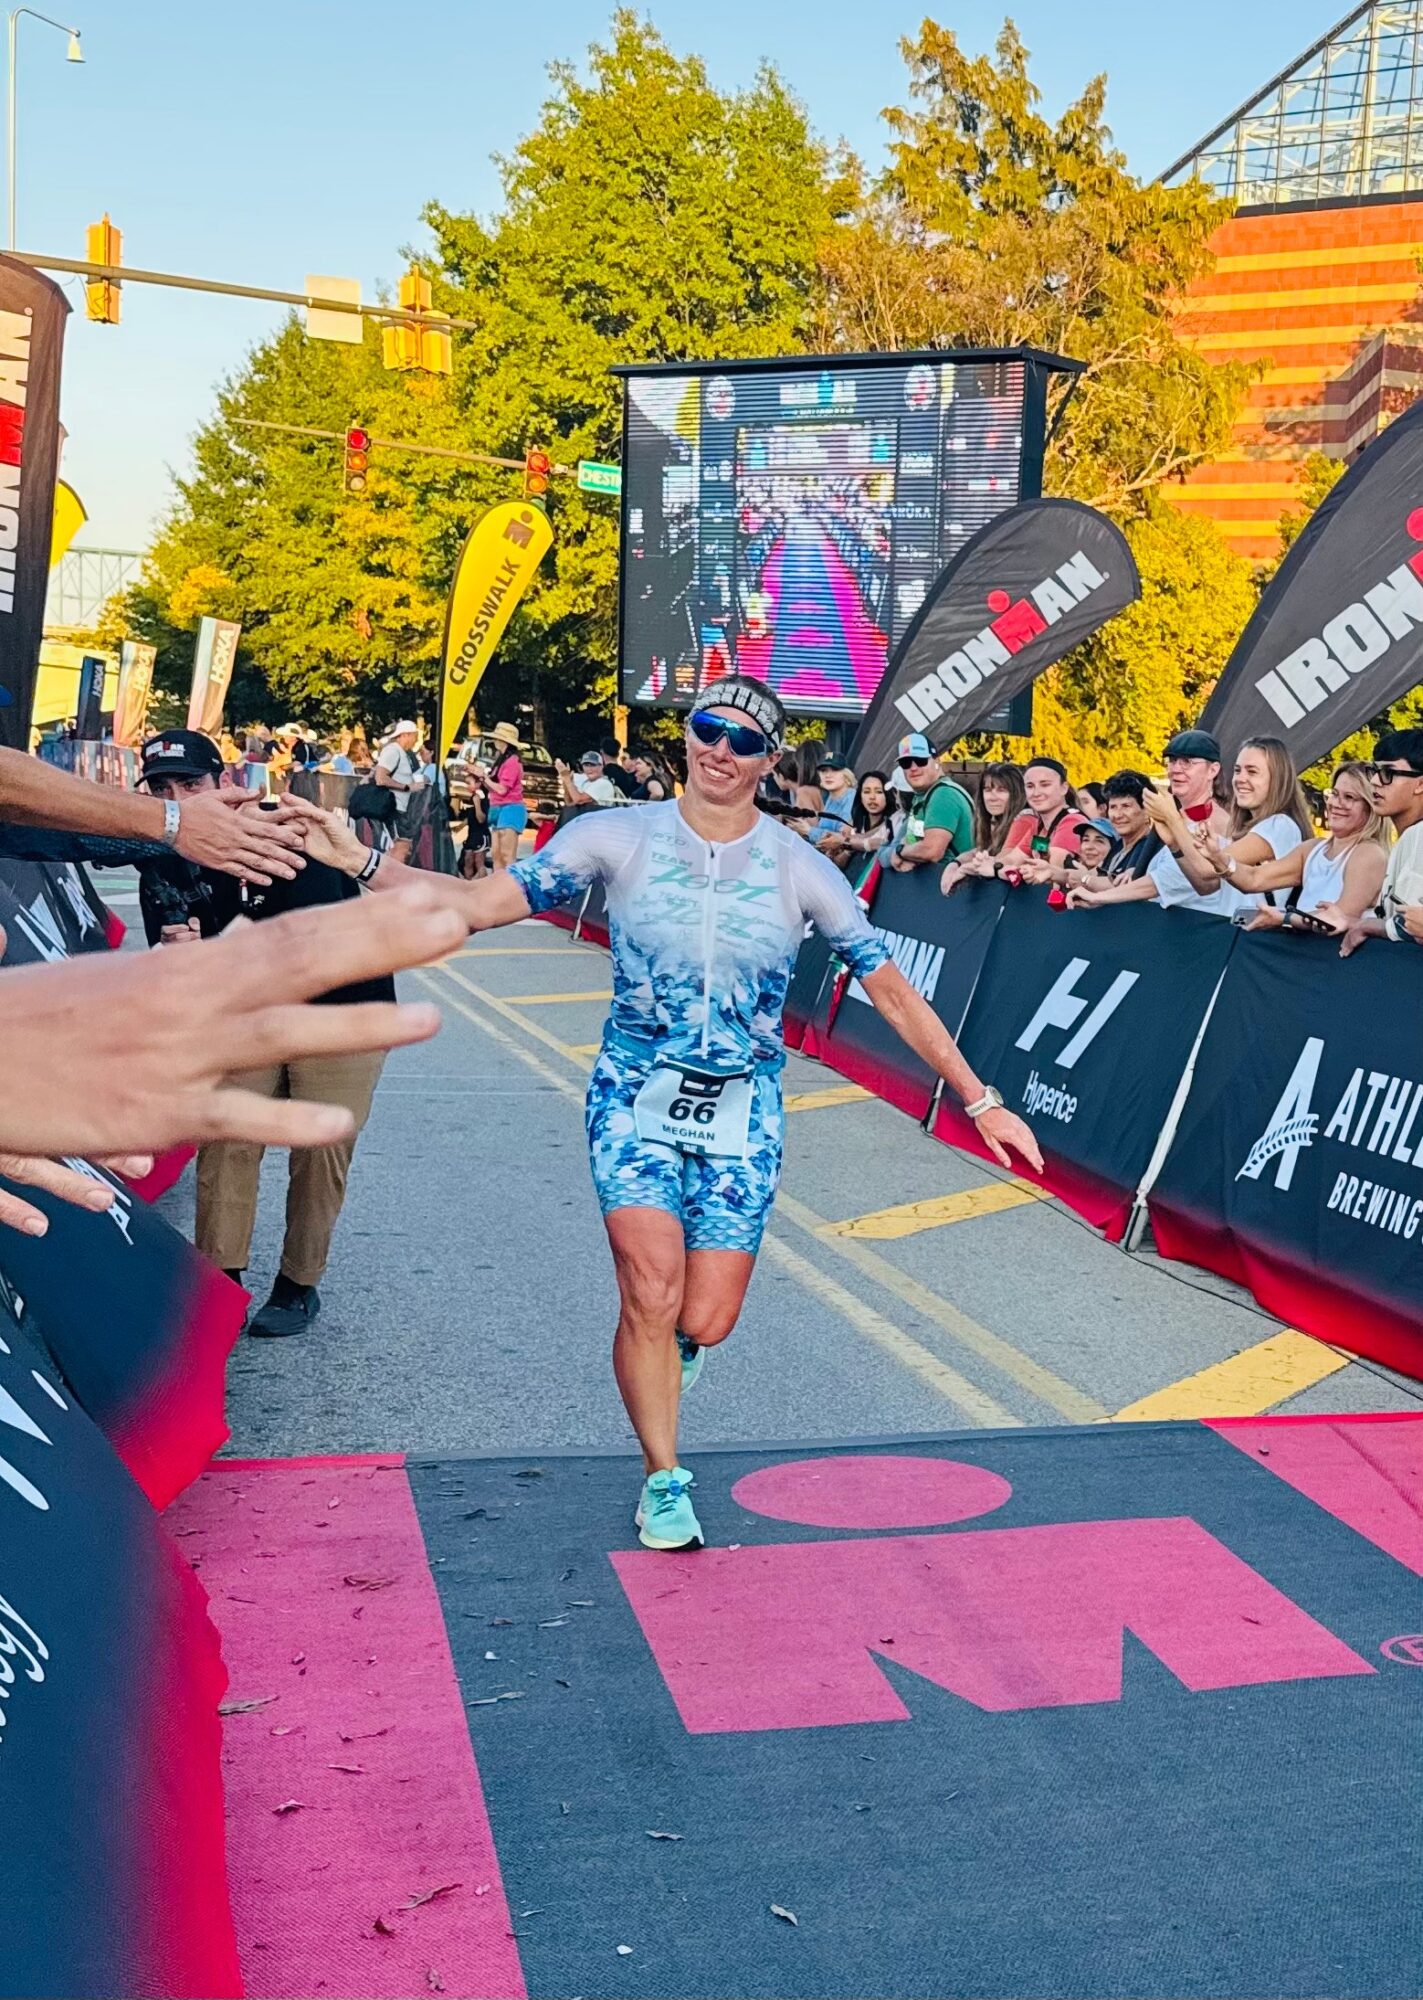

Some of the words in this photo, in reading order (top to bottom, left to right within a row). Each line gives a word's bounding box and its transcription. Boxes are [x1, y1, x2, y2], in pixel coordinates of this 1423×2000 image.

[449, 557, 520, 686] CROSSWALK
[894, 550, 1106, 733] IRONMAN
[1255, 546, 1423, 729] IRON
[91, 664, 104, 697] HOKA
[133, 649, 151, 692] HOKA
[210, 629, 235, 685] HOKA
[651, 851, 693, 867] TEAM
[872, 926, 946, 1002] VANA
[668, 1097, 717, 1125] 66
[1021, 1069, 1078, 1124] Hyperice
[662, 1123, 715, 1141] MEGHAN
[1326, 1171, 1423, 1239] BREWING
